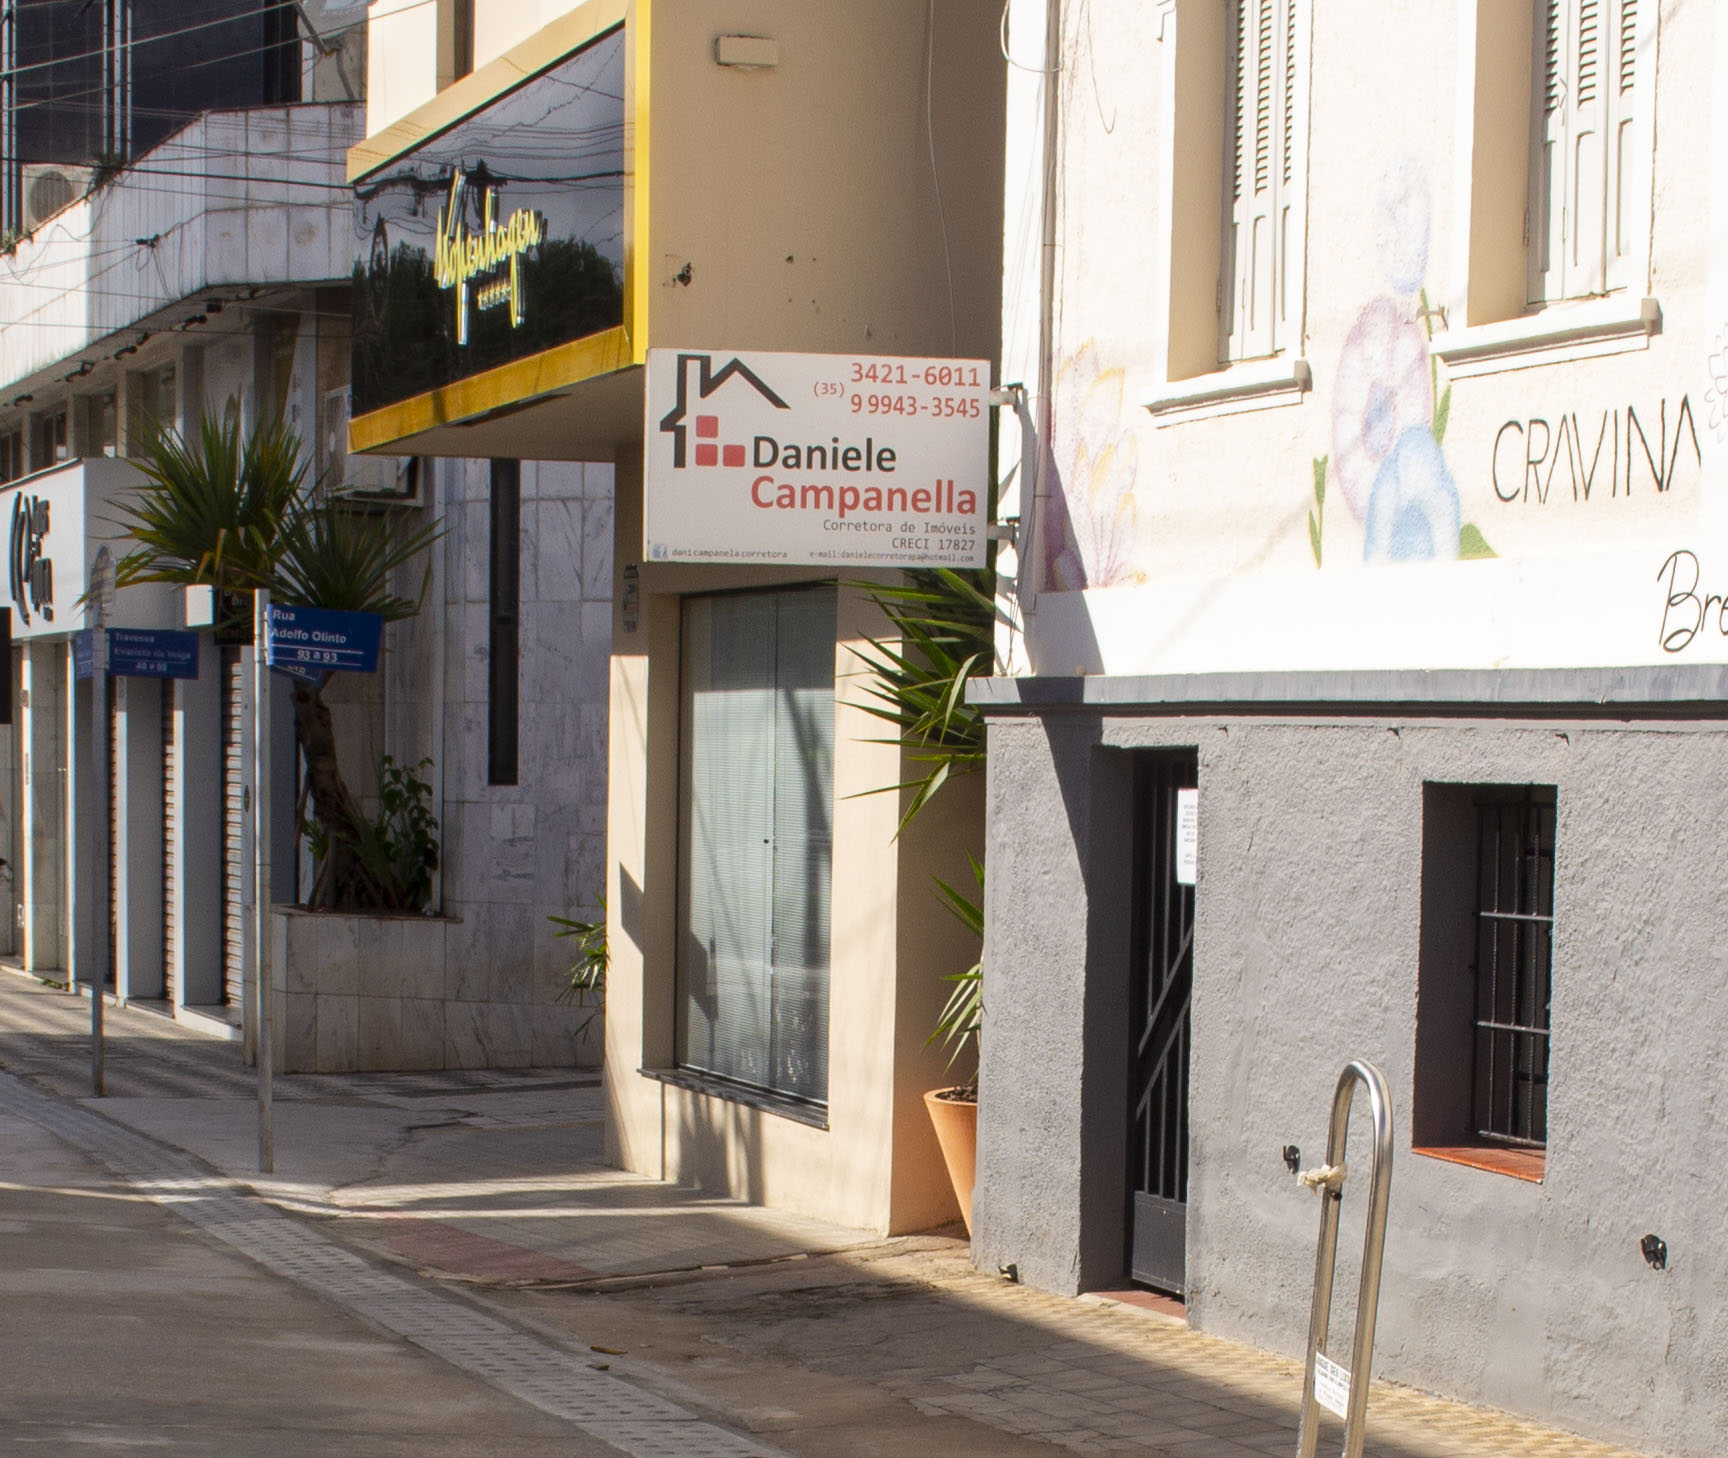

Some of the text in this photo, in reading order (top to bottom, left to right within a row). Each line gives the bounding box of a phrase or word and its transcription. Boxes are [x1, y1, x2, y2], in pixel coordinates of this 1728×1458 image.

[850, 362, 981, 387] 3421-6011
[813, 382, 846, 398] (35)
[753, 436, 897, 473] Daniele
[1493, 393, 1701, 504] CRAVINA
[751, 475, 977, 518] Campanella
[823, 519, 976, 535] Corretora de Imóveis
[891, 537, 976, 551] CRECI 17827
[273, 609, 296, 621] Rua
[271, 628, 347, 644] Adolfo Olinto
[297, 649, 338, 663] 93 a 93
